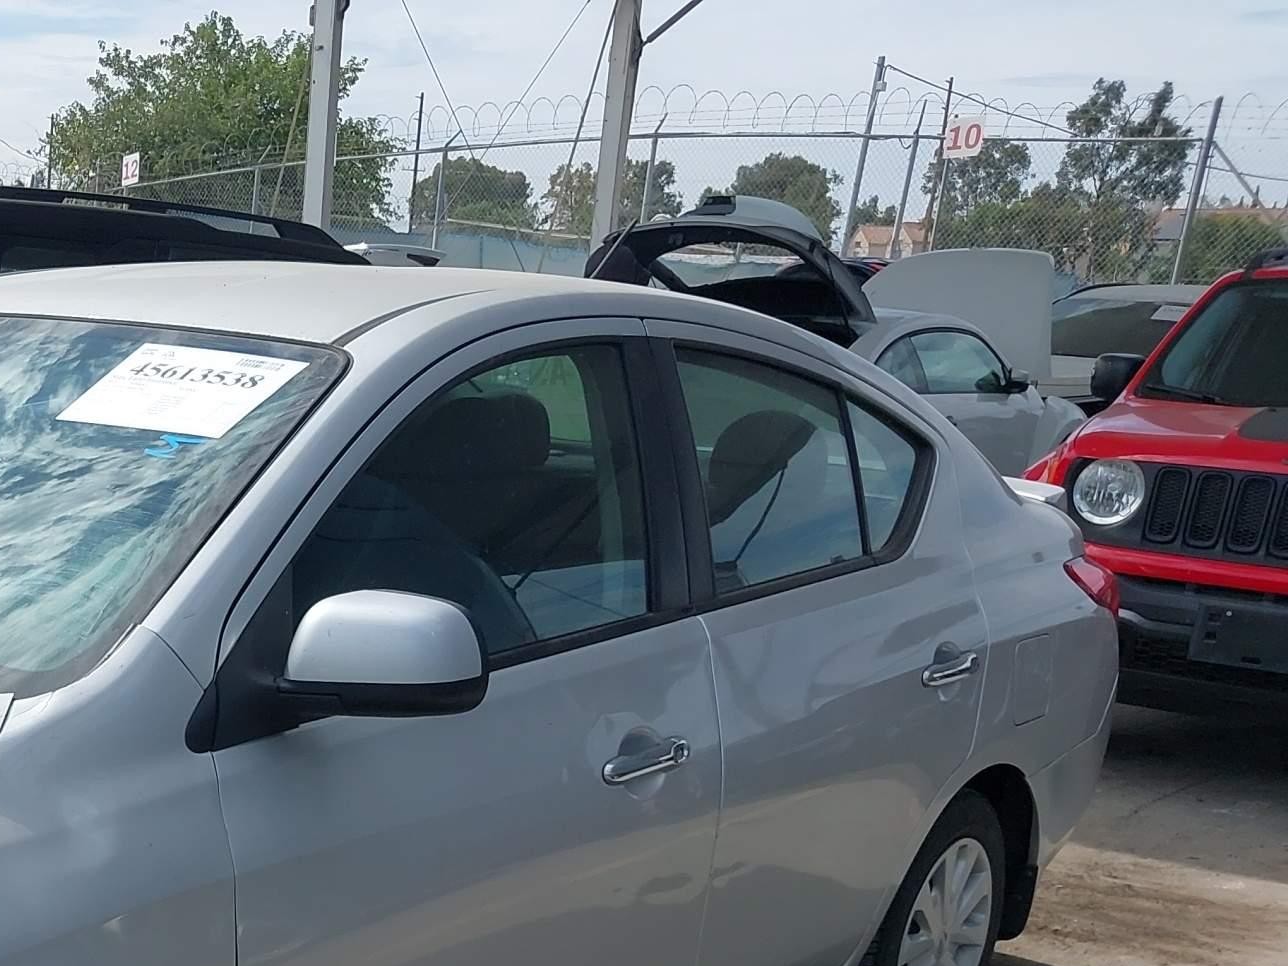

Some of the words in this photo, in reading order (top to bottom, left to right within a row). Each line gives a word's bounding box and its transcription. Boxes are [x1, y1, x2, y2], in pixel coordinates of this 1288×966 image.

[947, 123, 982, 151] 10
[123, 160, 138, 180] 12
[130, 361, 265, 389] 45613538
